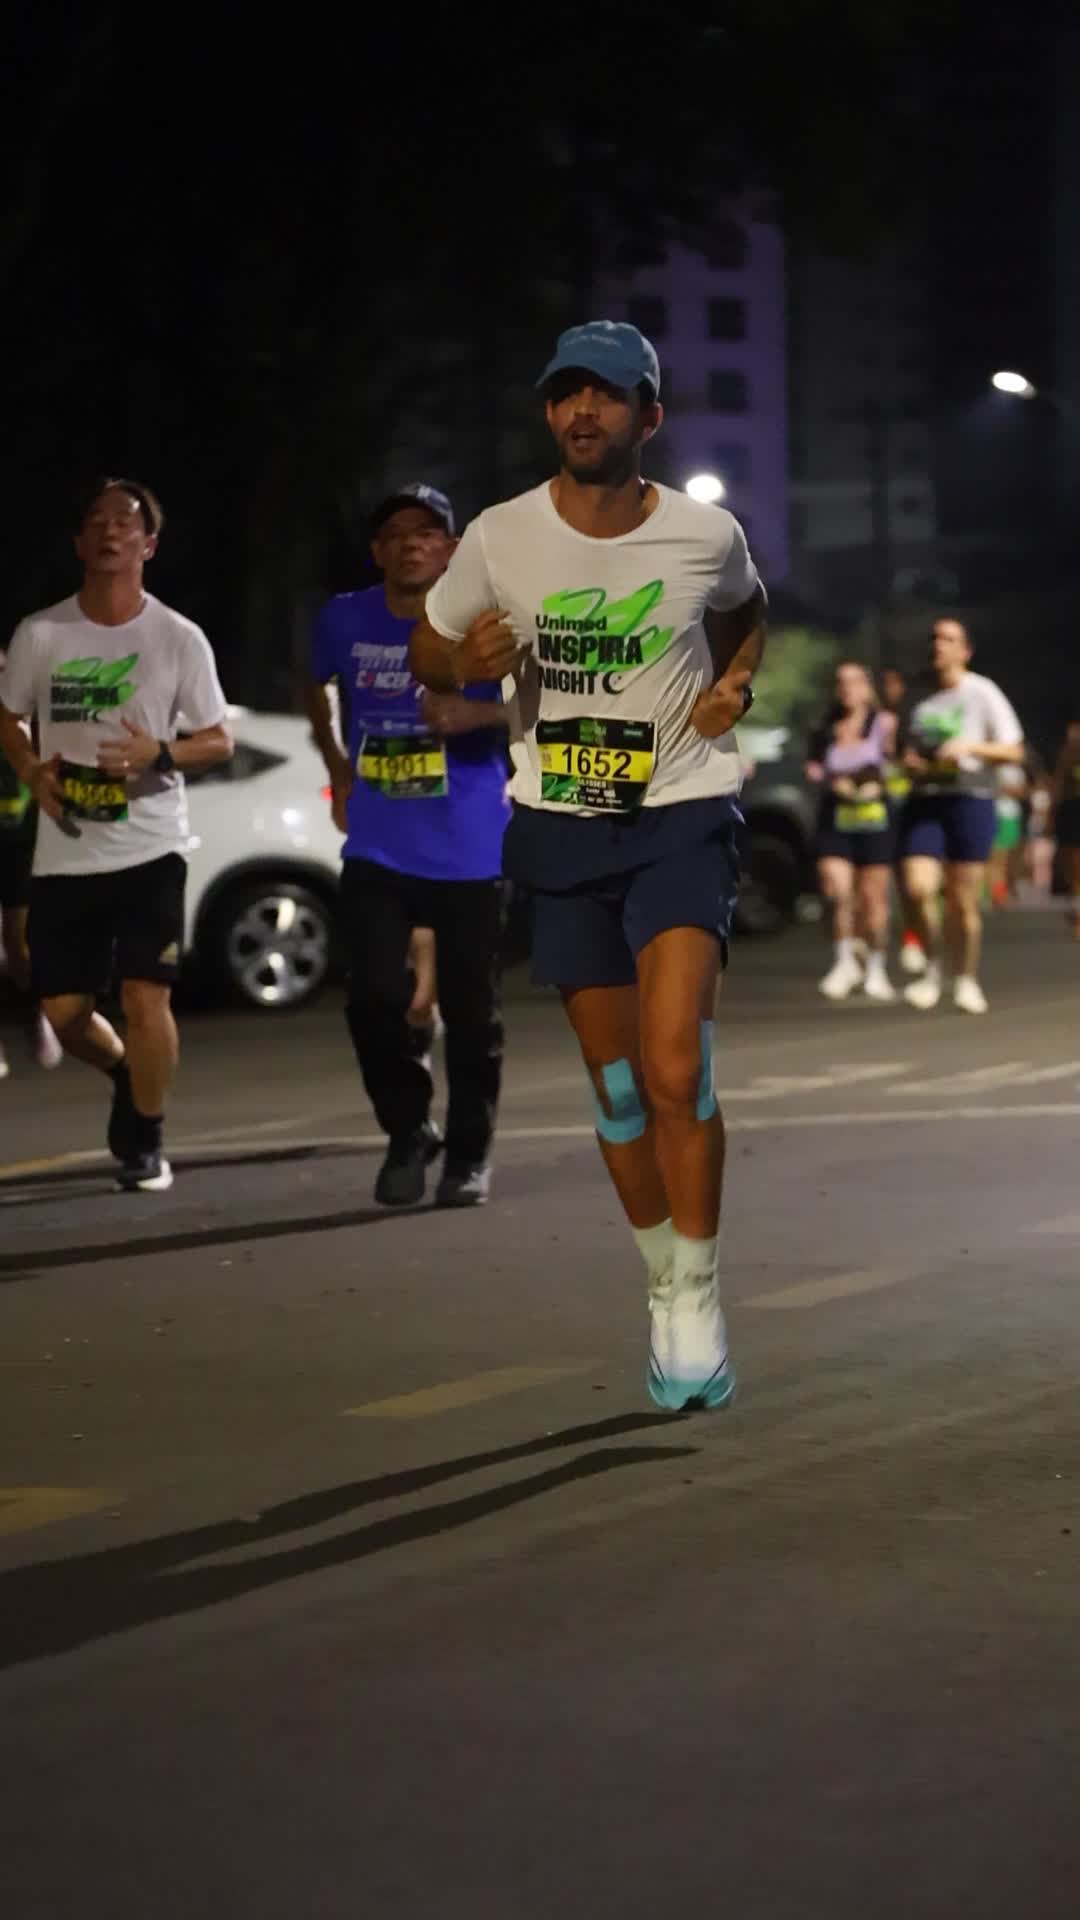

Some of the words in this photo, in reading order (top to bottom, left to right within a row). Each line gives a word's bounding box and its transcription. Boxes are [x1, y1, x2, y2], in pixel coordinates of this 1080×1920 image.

[536, 614, 608, 632] Unimed
[538, 633, 644, 665] INSPIRA
[538, 666, 599, 695] NIGHT
[373, 755, 429, 778] 1901
[562, 744, 632, 779] 1652
